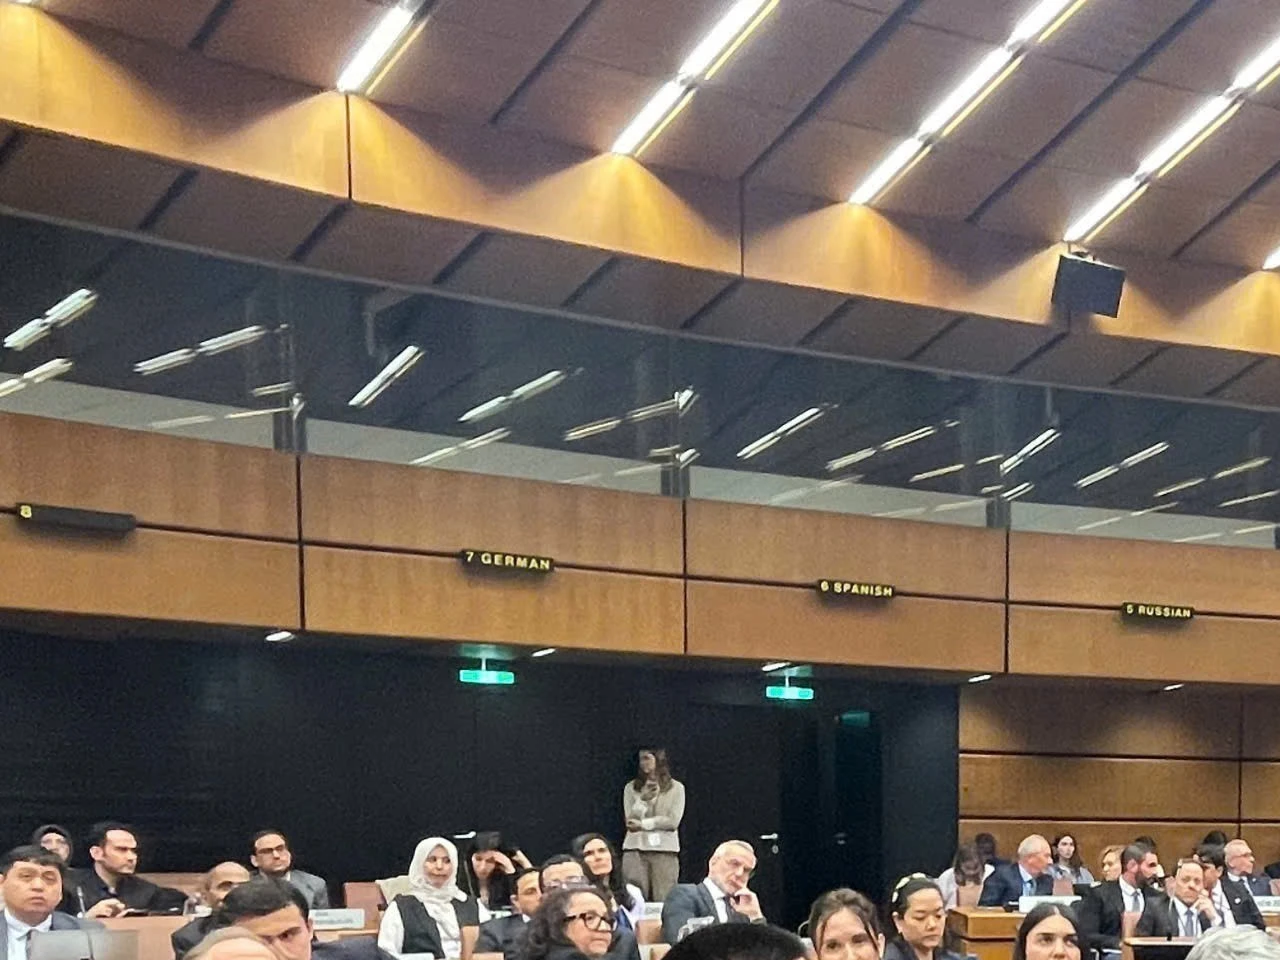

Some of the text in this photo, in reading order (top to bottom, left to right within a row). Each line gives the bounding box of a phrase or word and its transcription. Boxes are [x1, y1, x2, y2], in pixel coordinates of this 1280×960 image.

[20, 505, 32, 518] 8
[465, 551, 550, 570] 7 GERMAN
[820, 580, 893, 597] 6 SPANISH
[1126, 604, 1191, 618] 5 RUSSIAN
